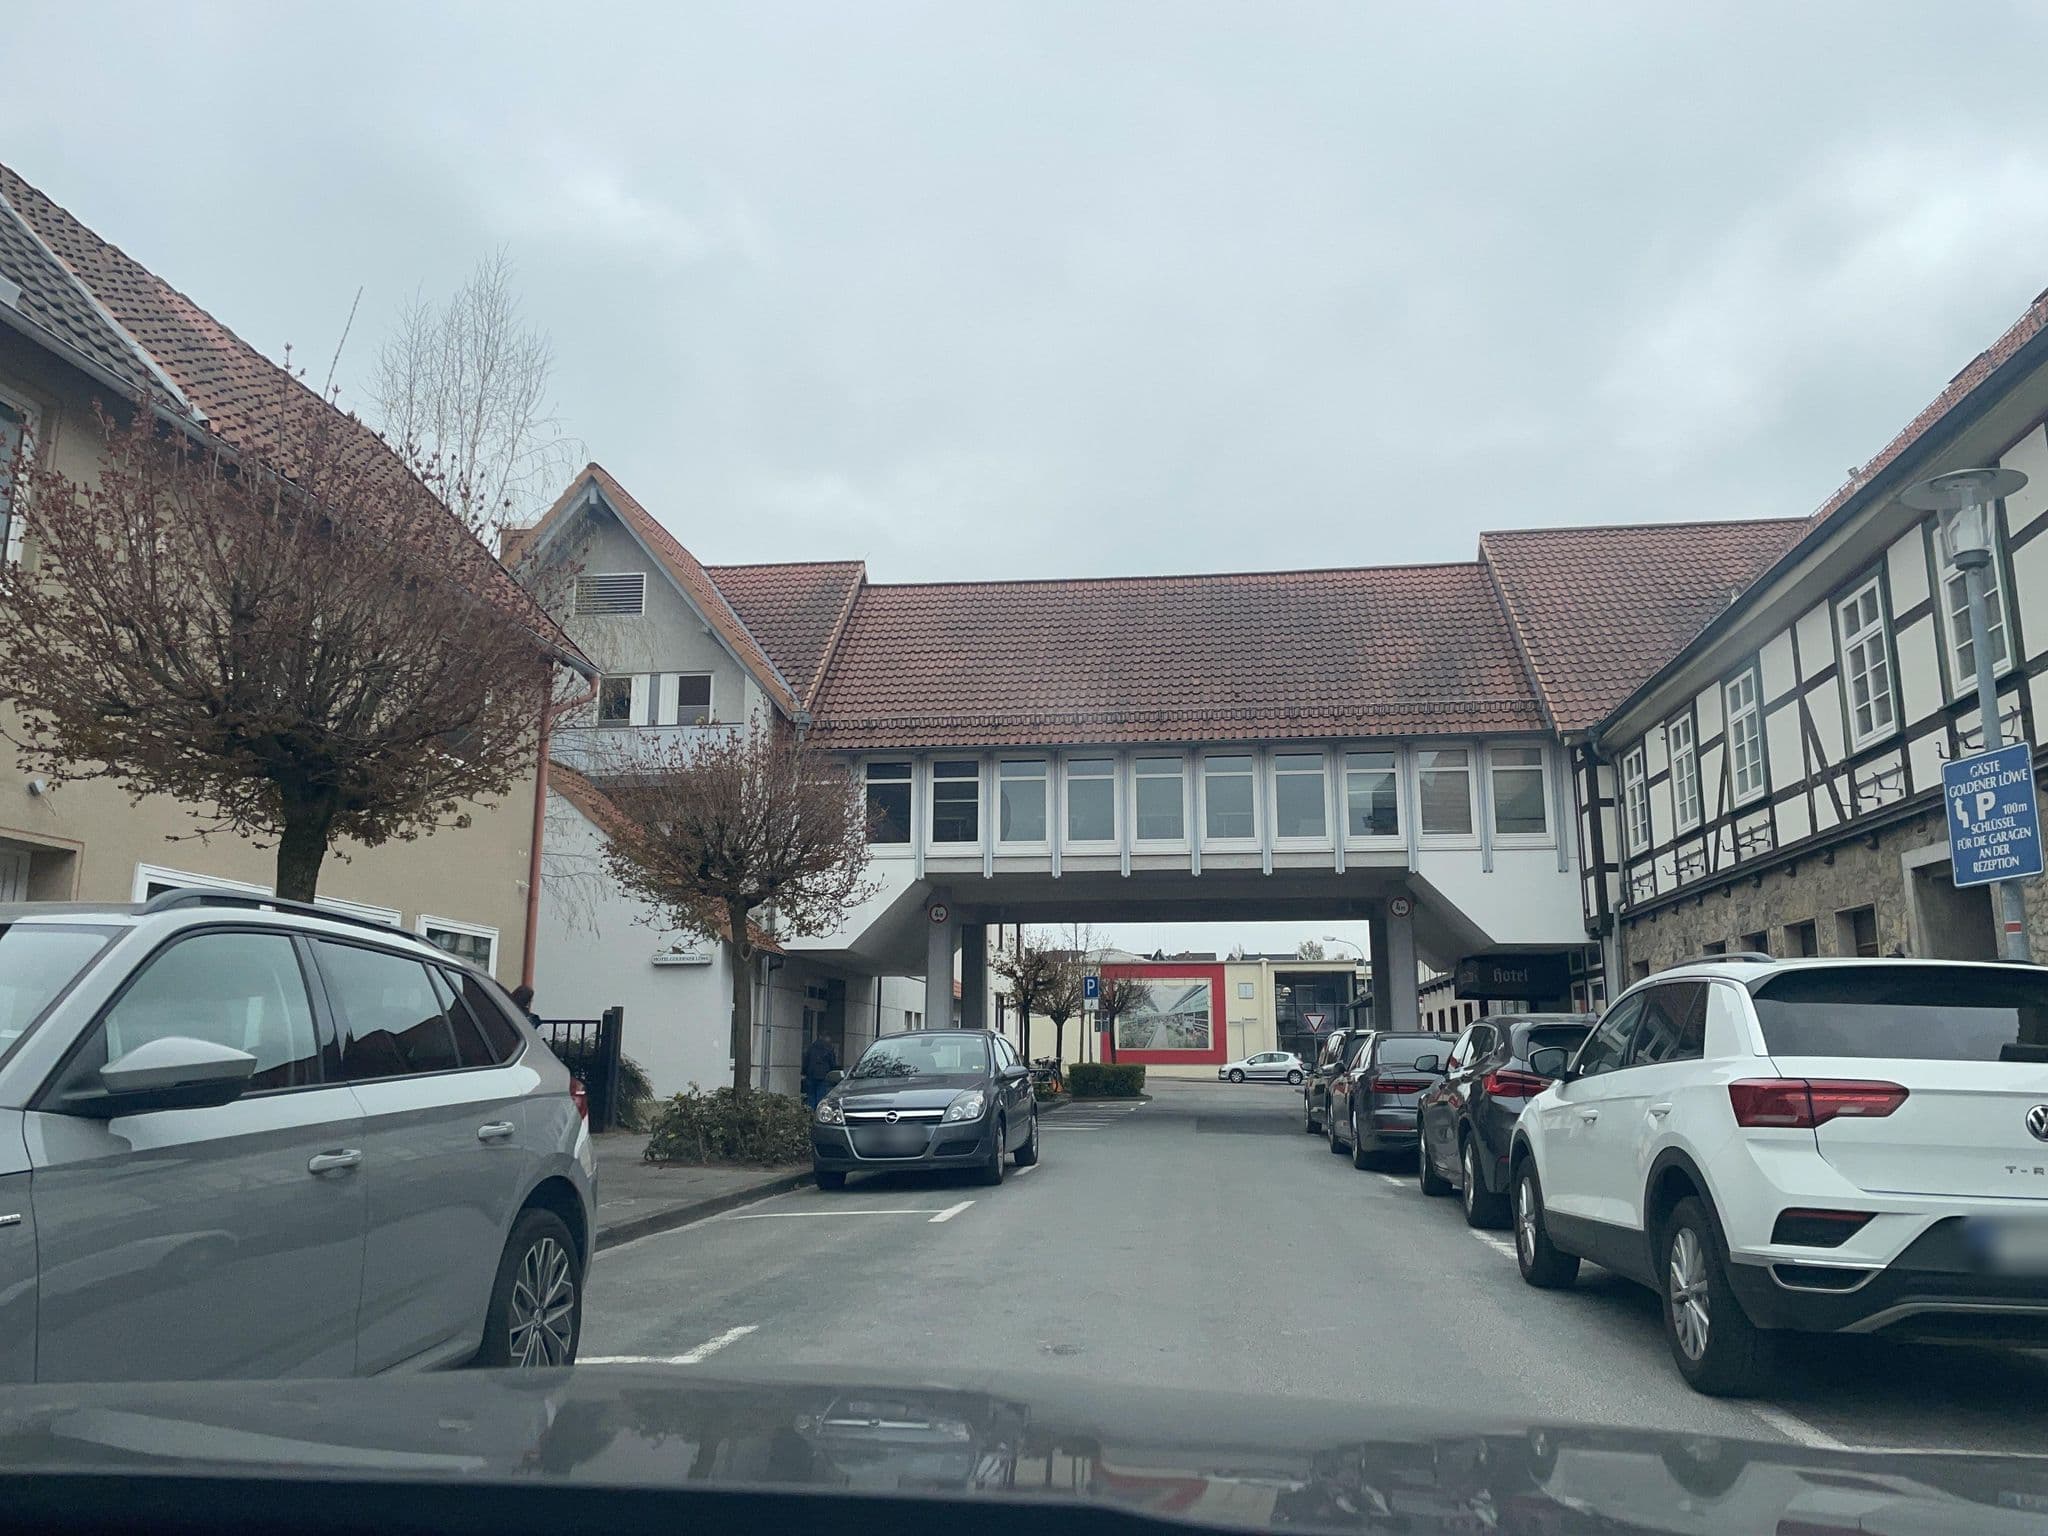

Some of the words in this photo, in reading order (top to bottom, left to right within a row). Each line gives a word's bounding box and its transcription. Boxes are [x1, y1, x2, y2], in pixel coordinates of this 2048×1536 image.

[1970, 760, 2000, 777] GÄSTE
[1949, 776, 1997, 798] GOLDENER
[1999, 768, 2028, 786] LÖWE
[1976, 791, 1996, 820] P
[1971, 816, 2016, 834] SCHLÜSSEL
[1957, 838, 1973, 850] FÜR
[1974, 835, 1988, 847] DIE
[1989, 826, 2032, 844] GARAGEN
[1979, 847, 1992, 859] AN
[1993, 844, 2010, 856] DER
[1973, 856, 2019, 873] REZEPTION
[1087, 978, 1096, 996] P
